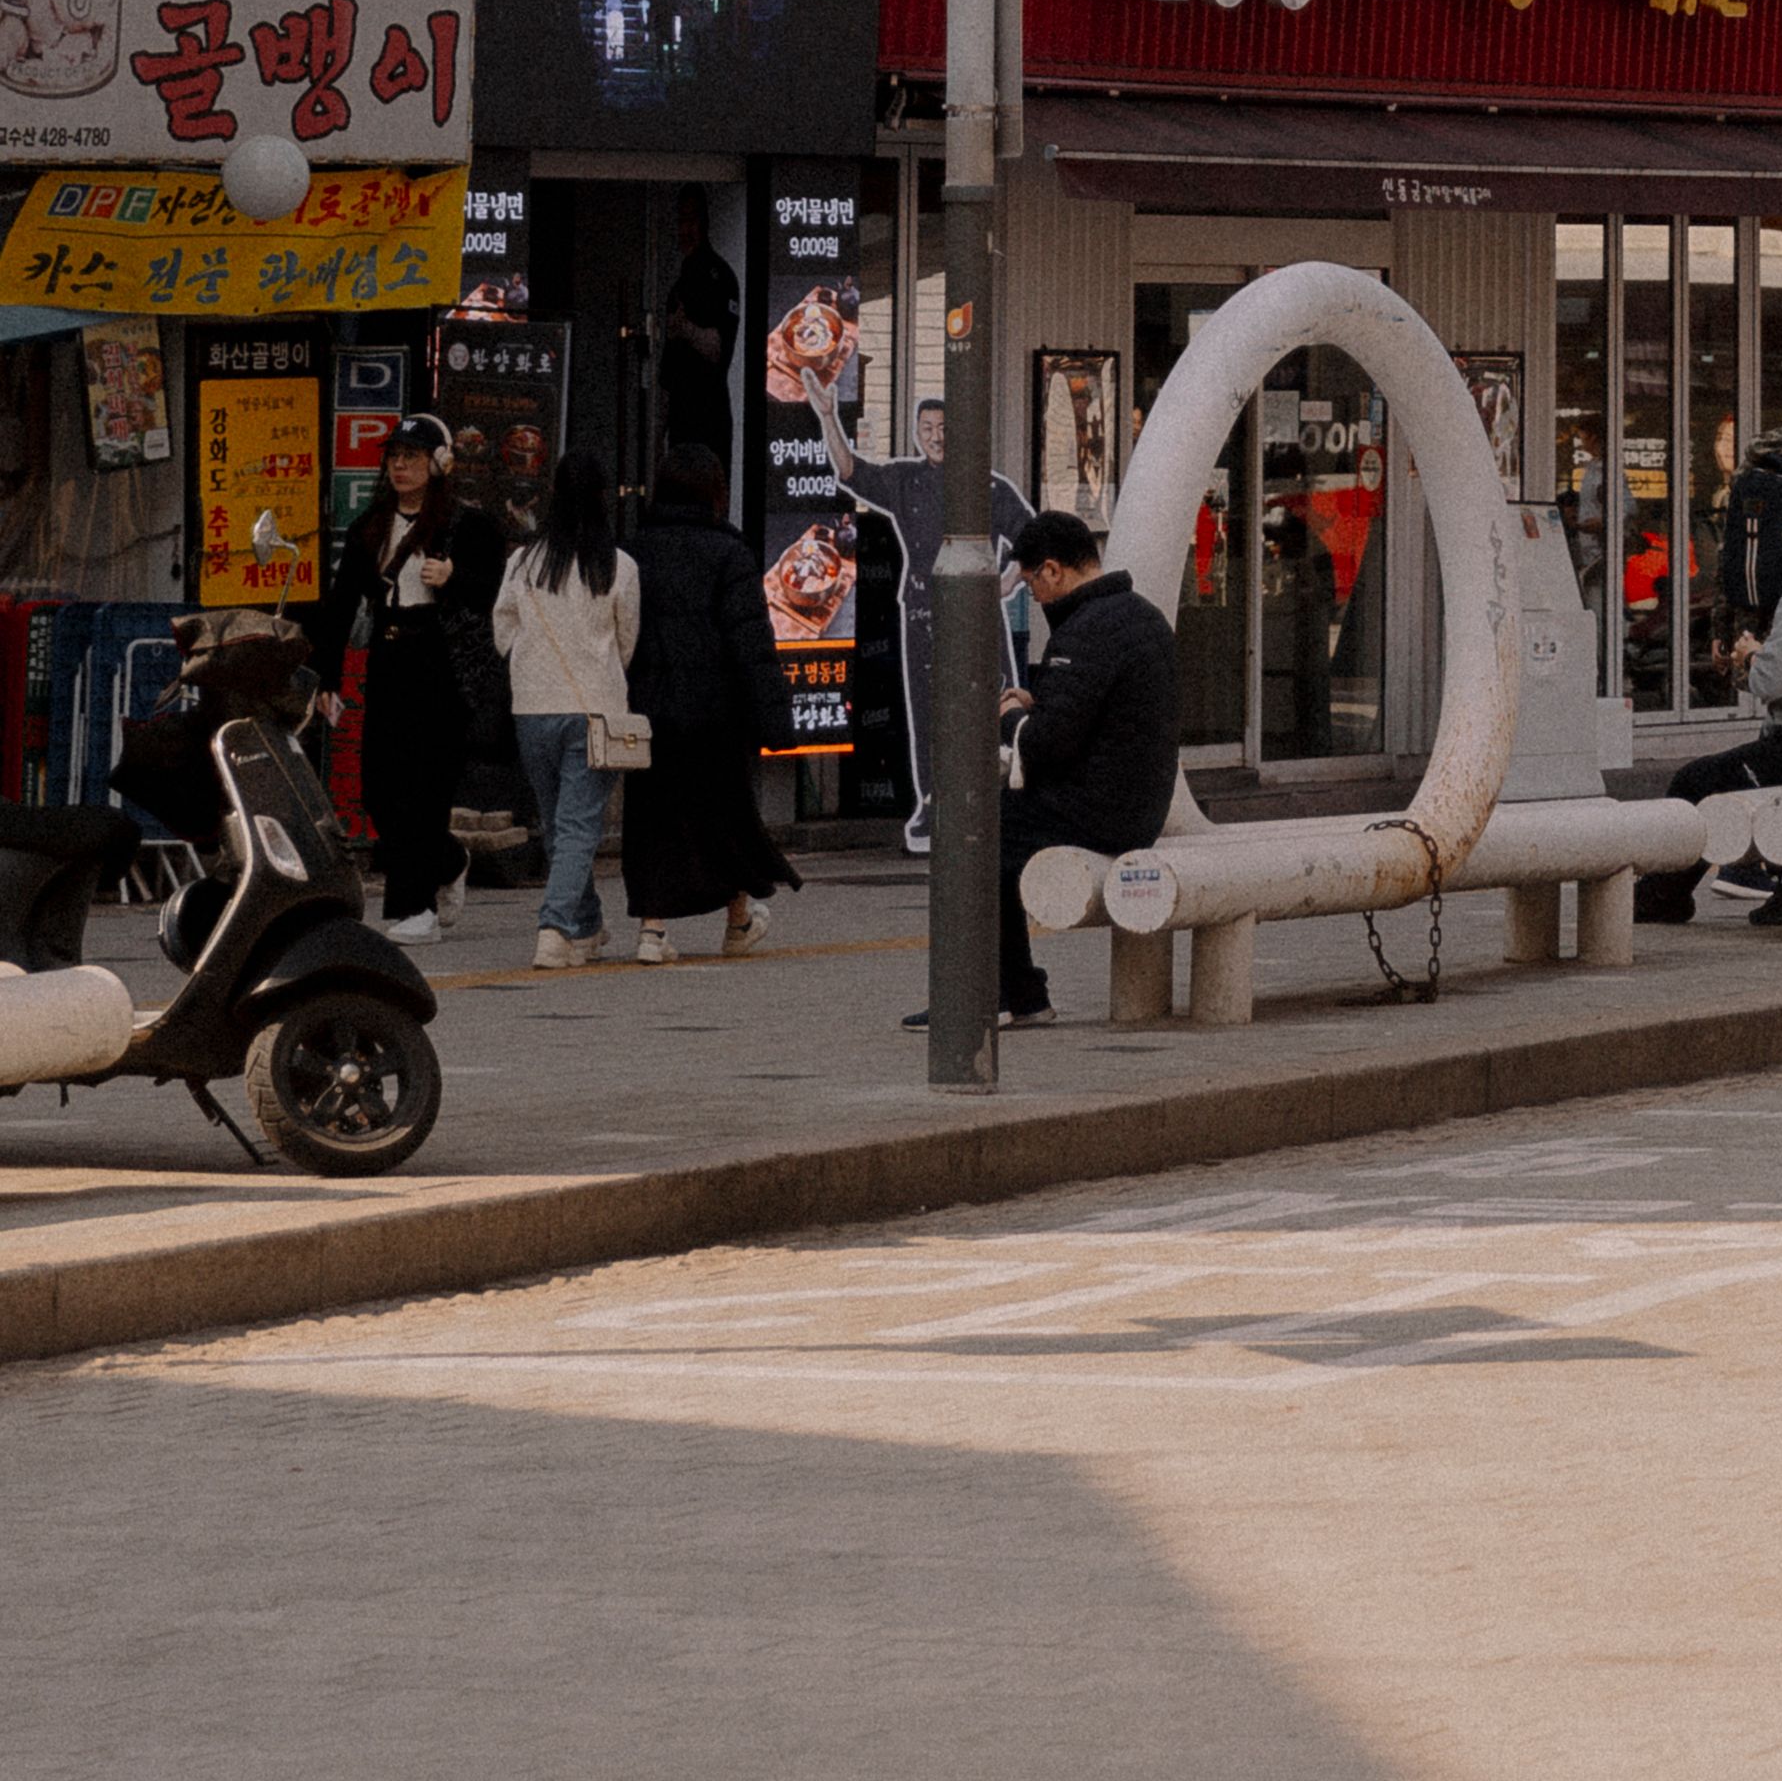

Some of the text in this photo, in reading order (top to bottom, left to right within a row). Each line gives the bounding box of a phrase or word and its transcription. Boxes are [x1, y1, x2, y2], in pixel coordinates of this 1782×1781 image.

[38, 126, 111, 148] 428-4780
[54, 187, 150, 219] DPF
[464, 191, 524, 221] 물냉면
[775, 196, 855, 226] 양지물냉면
[462, 232, 507, 255] ,000원
[789, 236, 840, 258] 9,000원
[25, 242, 433, 304] 카스 전문 판매업소
[207, 339, 312, 371] 화산골뱅이
[209, 408, 228, 492] 강화도
[786, 475, 838, 498] 9,000원
[804, 660, 848, 685] 명동점
